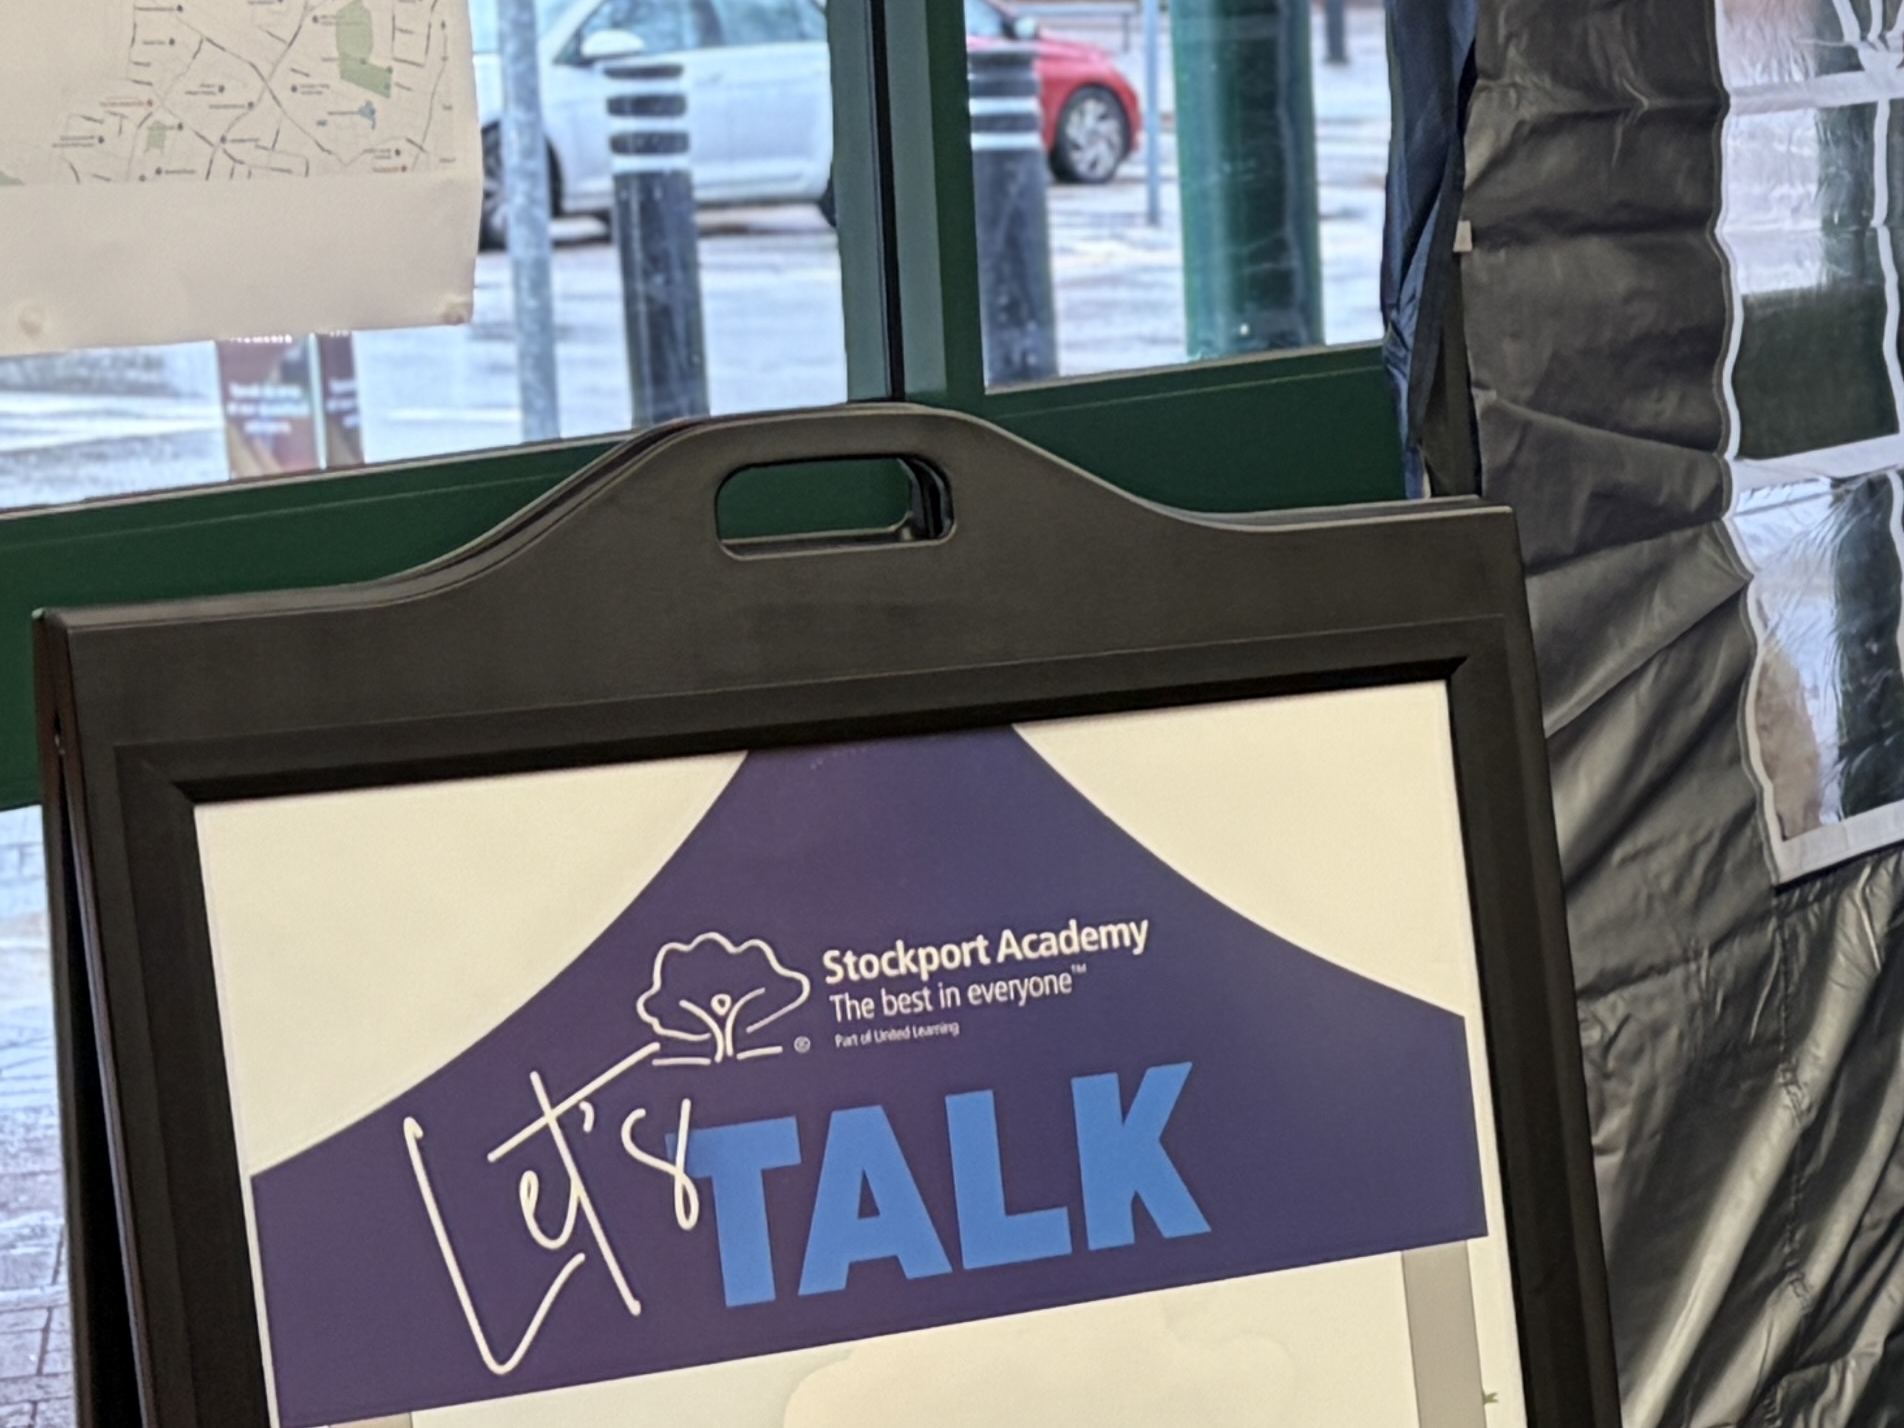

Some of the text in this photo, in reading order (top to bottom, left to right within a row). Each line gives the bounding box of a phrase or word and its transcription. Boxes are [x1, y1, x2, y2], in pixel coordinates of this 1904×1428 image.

[822, 918, 1149, 984] Stockport Academy
[829, 992, 875, 1022] The
[881, 985, 933, 1016] best
[938, 982, 961, 1009] in
[834, 1021, 960, 1048] Part of United Learning
[403, 1042, 700, 1374] Let's
[667, 1061, 1212, 1308] TALK
